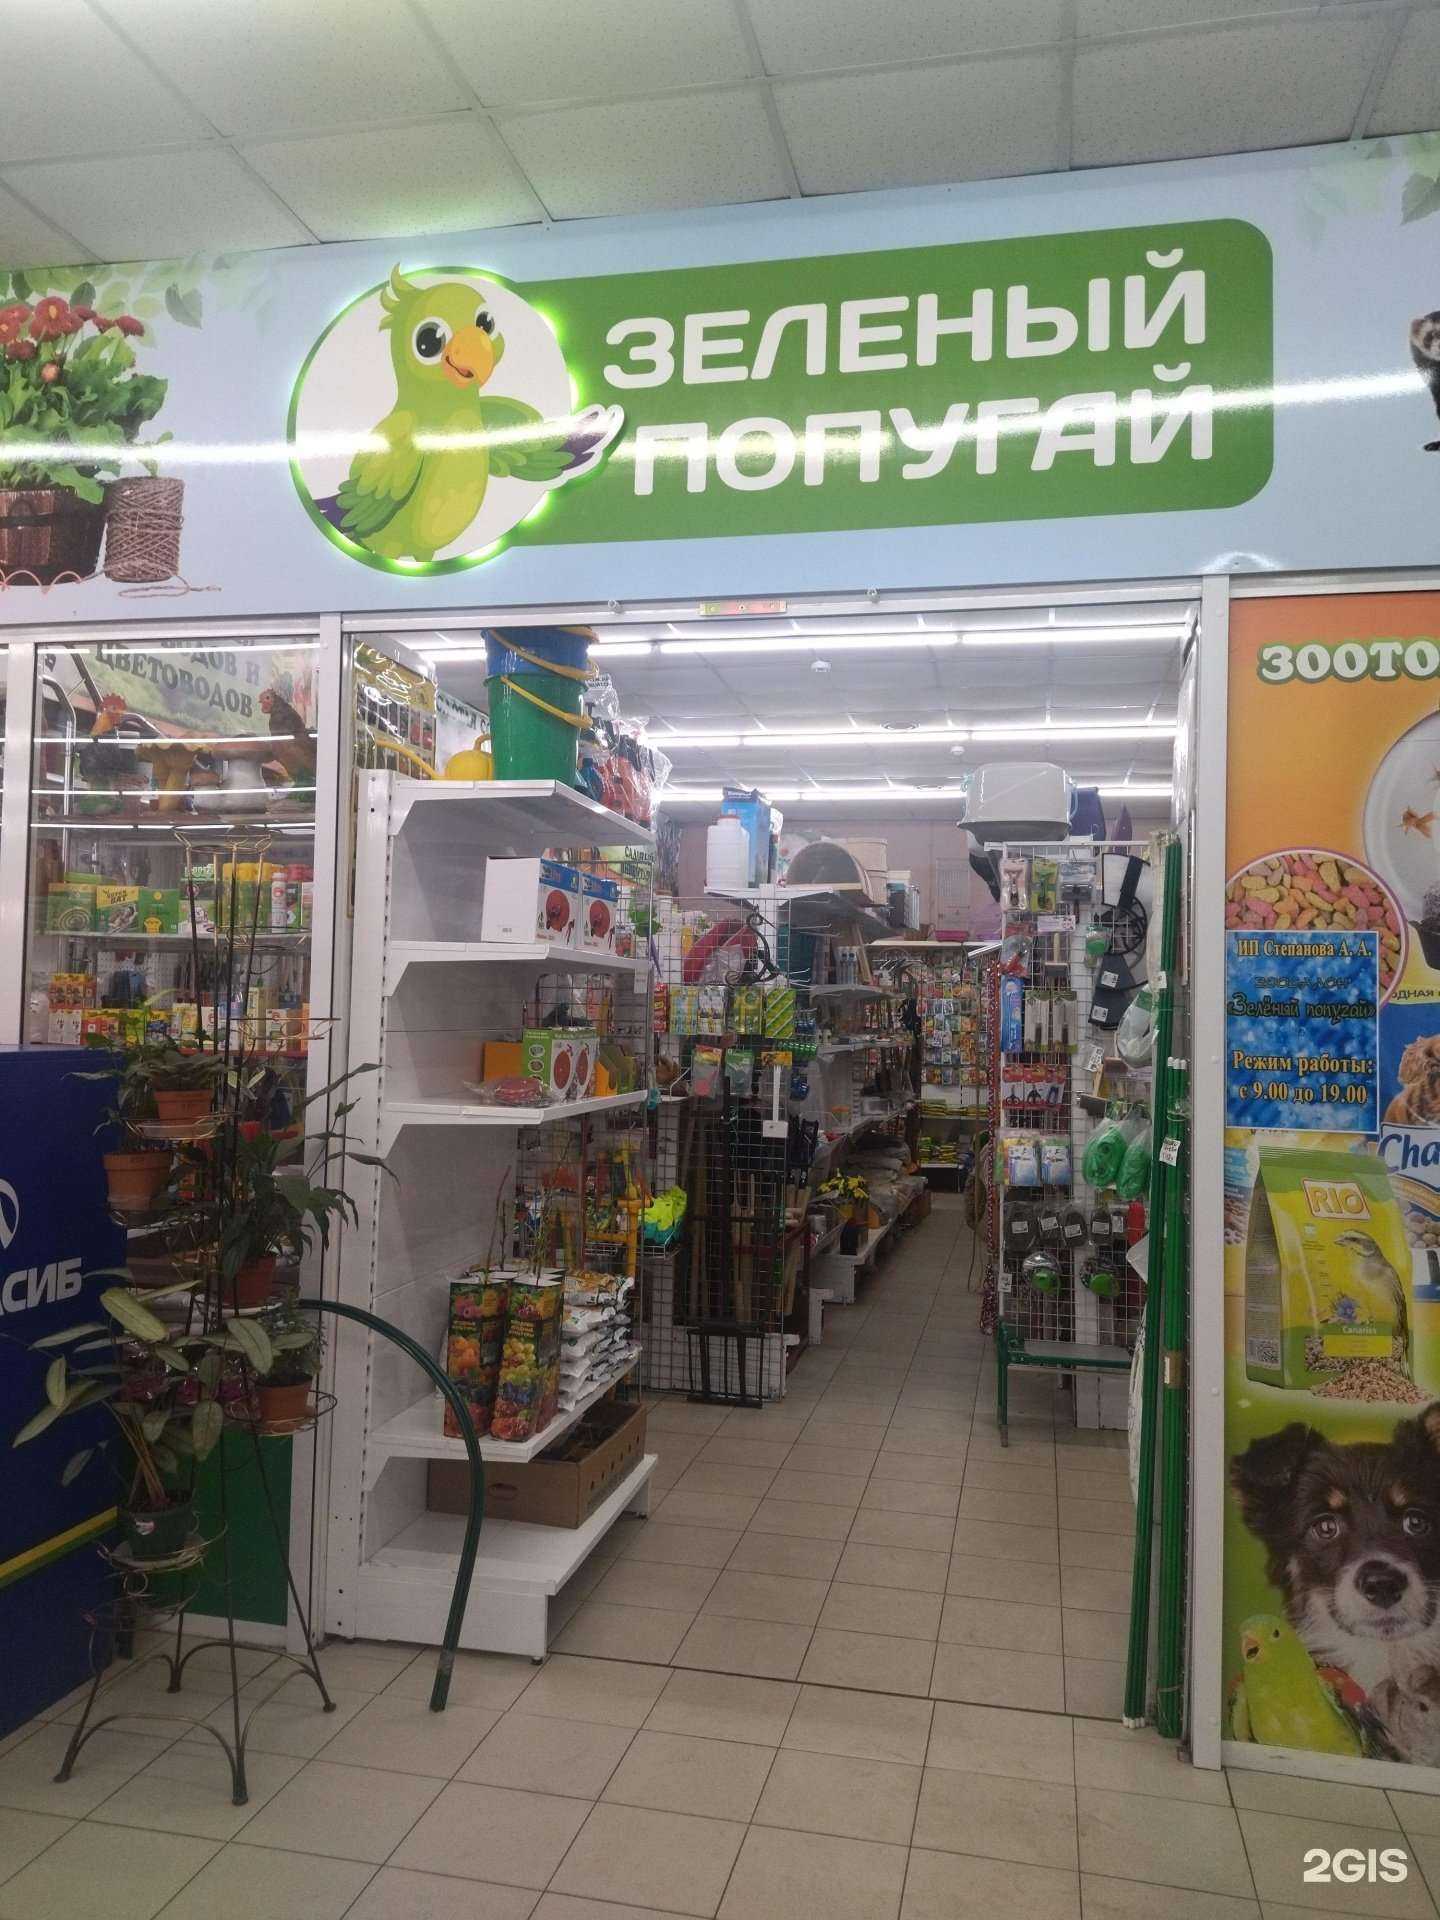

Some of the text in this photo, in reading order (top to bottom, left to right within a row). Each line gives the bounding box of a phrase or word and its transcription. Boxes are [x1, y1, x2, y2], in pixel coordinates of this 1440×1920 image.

[603, 248, 1205, 389] ЗЕЛЕНЫЙ
[634, 361, 1213, 496] ПОПУГАЙ
[1237, 940, 1373, 957] ИП Степанова А. А.
[1233, 1050, 1374, 1076] Режим работы:
[1239, 1082, 1368, 1104] с 9.00 до 19.00
[1309, 1186, 1365, 1215] RIO
[0, 1257, 82, 1316] СИБ
